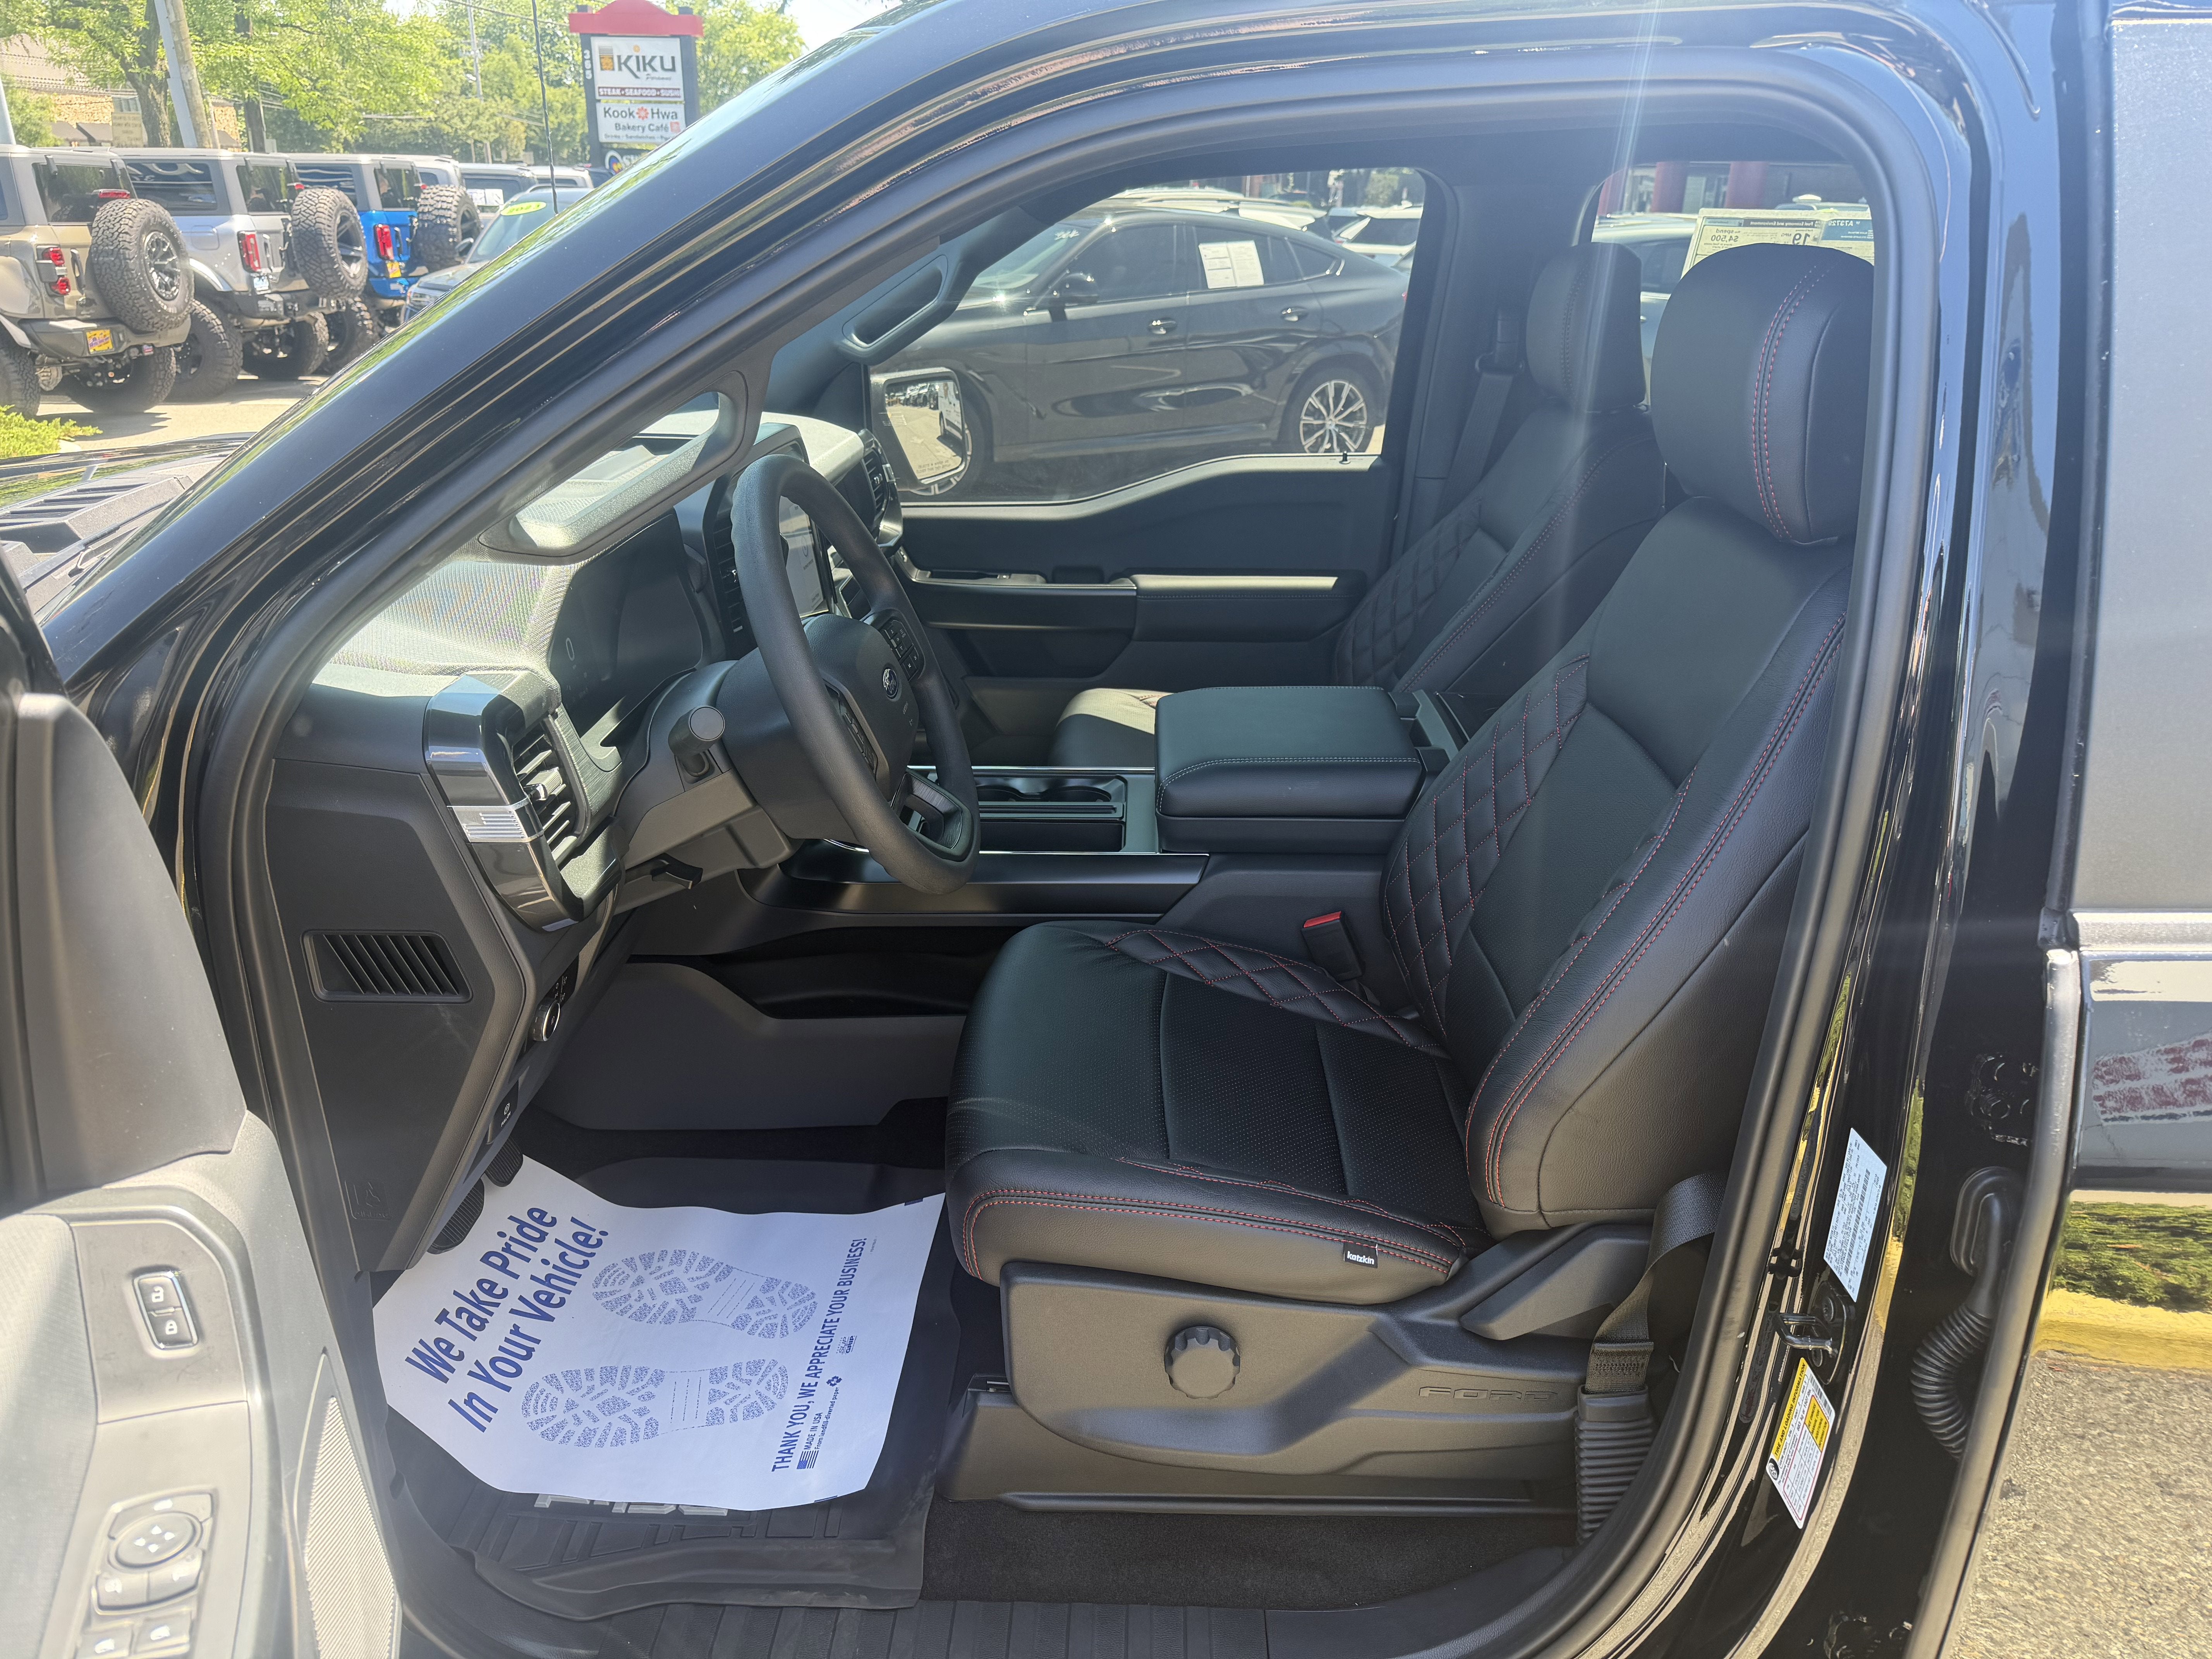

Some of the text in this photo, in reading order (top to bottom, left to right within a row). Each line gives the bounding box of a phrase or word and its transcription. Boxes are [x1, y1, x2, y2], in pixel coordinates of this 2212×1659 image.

[617, 46, 676, 79] KIKU
[604, 106, 678, 120] Kook Hwa
[615, 122, 669, 133] Bakery Café
[1347, 1251, 1374, 1265] katzkin
[405, 1208, 557, 1384] We Take Pride
[448, 1216, 608, 1432] In Your Vehicle!
[772, 1238, 867, 1472] THANK YOU, WE APPRECIATE YOUR BUSINESS!
[1419, 1386, 1558, 1401] FORD
[1783, 1402, 1793, 1431] LOADING
[1791, 1362, 1806, 1404] INFORMATION
[804, 1433, 815, 1449] MADE
[813, 1413, 823, 1424] USA
[815, 1437, 823, 1449] From
[819, 1401, 835, 1436] landfill-diverted
[1818, 1420, 1827, 1448] INFORMATION
